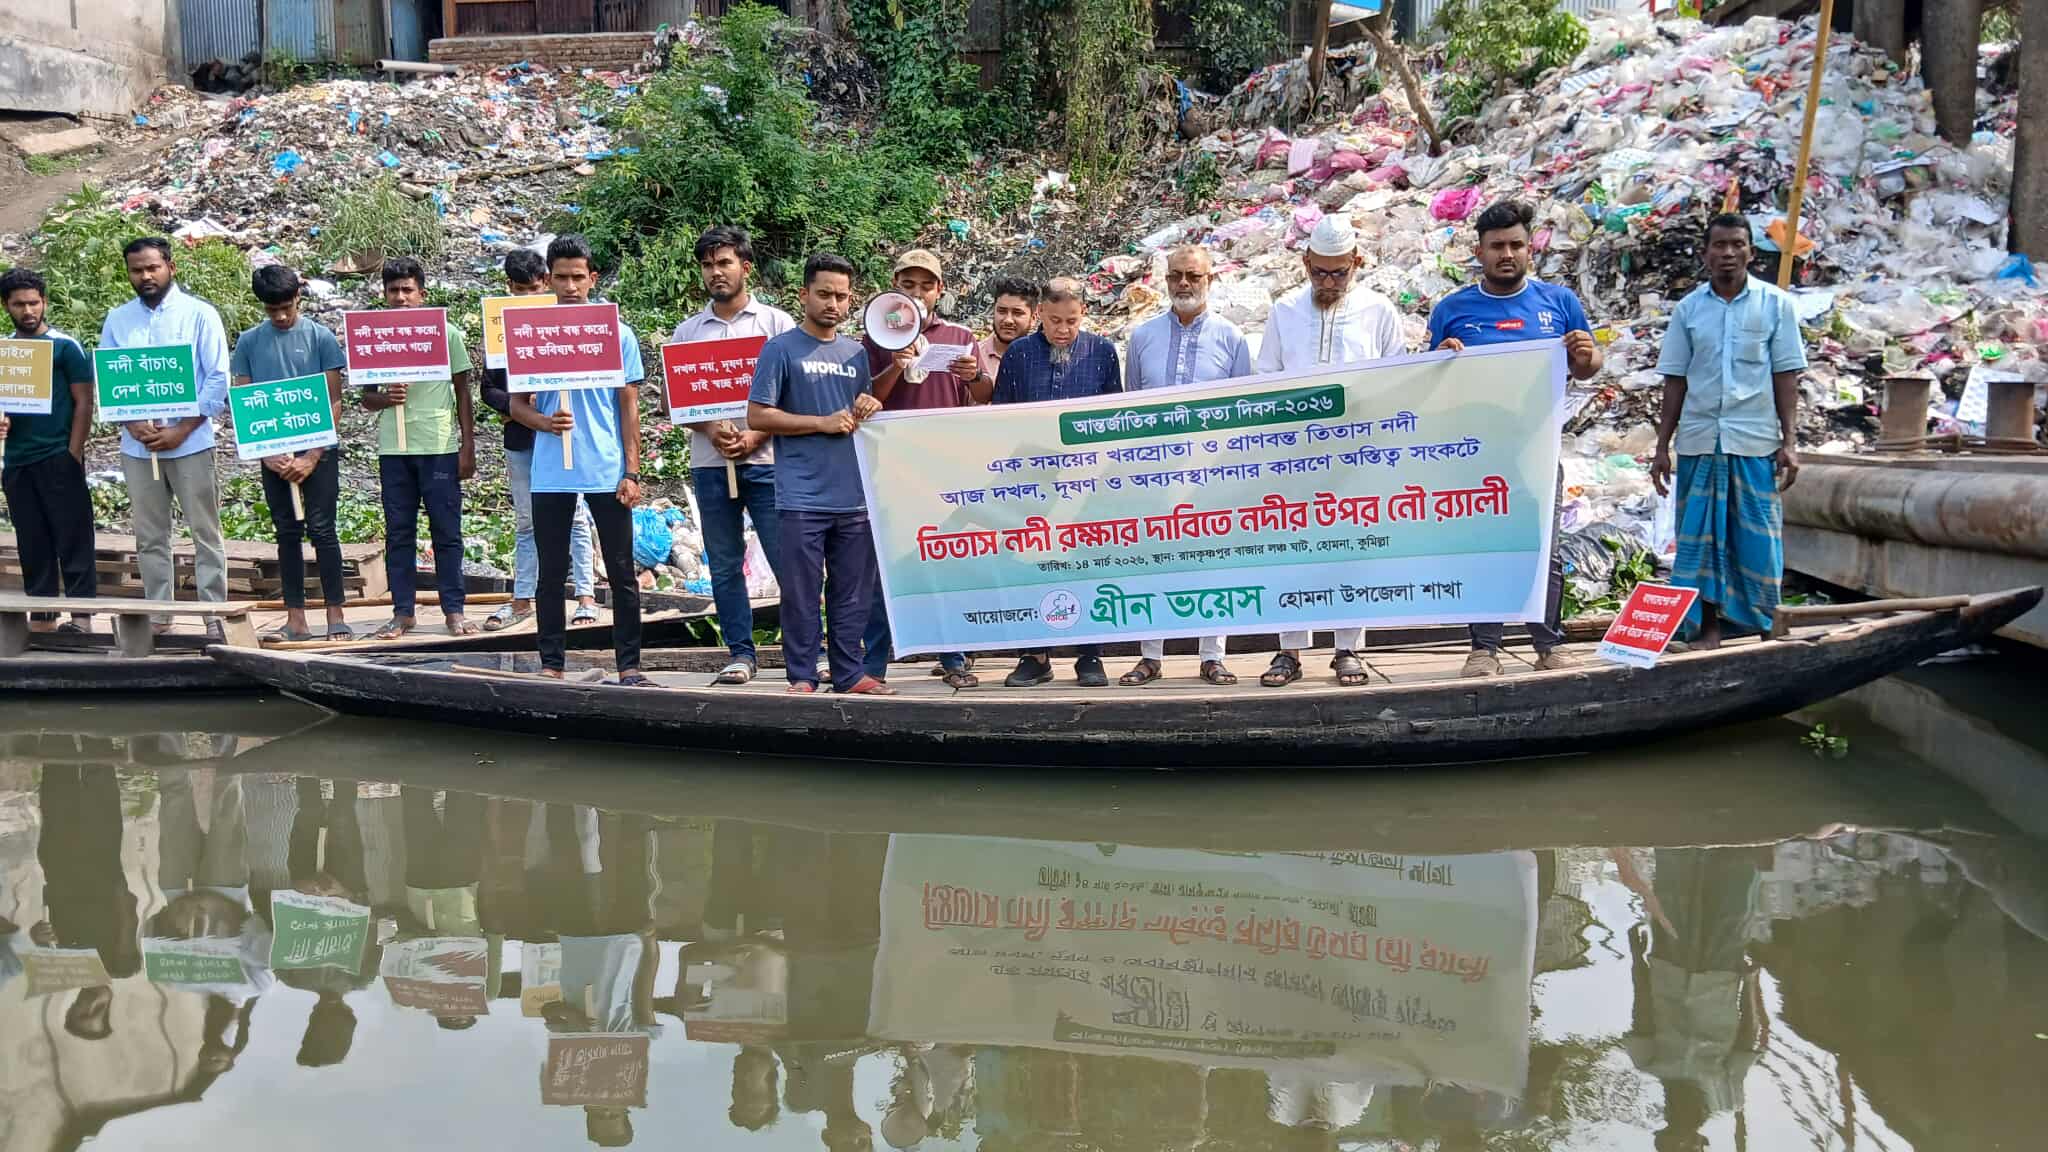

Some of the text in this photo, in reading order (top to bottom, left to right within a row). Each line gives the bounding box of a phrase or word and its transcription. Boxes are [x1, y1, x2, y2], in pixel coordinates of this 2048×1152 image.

[353, 325, 440, 339] নদী দূষণ বন্ধ করো,
[513, 323, 533, 339] নদী
[536, 325, 560, 340] দূষণ
[562, 325, 580, 337] বন্ধ
[582, 323, 613, 336] করো,
[355, 340, 432, 357] সুস্থ ভবিষ্যৎ গড়ো
[514, 342, 603, 359] সুস্থ ভবিষ্যৎ গড়ো
[106, 355, 183, 374] নদী বাঁচাও,
[672, 363, 697, 375] দখল
[699, 362, 719, 373] নয়,
[720, 359, 743, 374] দূষণ
[802, 361, 857, 378] WORLD
[112, 379, 185, 400] দেশ বাঁচাও
[690, 379, 710, 392] চাই
[241, 388, 319, 409] নদী বাঁচাও,
[249, 412, 320, 435] দেশ বাঁচাও
[1072, 396, 1333, 435] আন্তর্জাতিক নদী কৃত্য দিবস-২০২৬
[987, 411, 1418, 473] এক সময়ের খরস্রোতা ও প্রাণবন্ত তিতাস নদী
[938, 436, 1480, 507] আজ দখল, দূষণ ও অব্যবস্থাপনার কারণে অস্তিত্ব সংকটে
[916, 524, 998, 562] তিতাস
[1002, 516, 1051, 553] নদী
[1056, 518, 1139, 553] রক্ষার
[1144, 504, 1233, 541] দাবিতে
[1238, 494, 1309, 532] নদীর
[1313, 492, 1380, 528] উপর
[1387, 485, 1427, 522] নৌ
[1037, 560, 1072, 573] তারিখ:
[1075, 559, 1089, 570] ১৪
[1093, 555, 1111, 569] মার্চ
[1114, 555, 1148, 567] ২০২৬,
[1152, 553, 1174, 565] স্থান:
[1177, 547, 1231, 563] রামকৃষ্ণপুর
[1234, 544, 1264, 557] বাজার
[1289, 540, 1313, 553] ঘাট,
[1316, 538, 1354, 552] হোমনা,
[1357, 534, 1391, 551] কুমিল্লা
[1090, 579, 1463, 628] গ্রীন ভয়েস হোমনা উপজেলা শাখা
[963, 607, 1038, 625] আয়োজনে:
